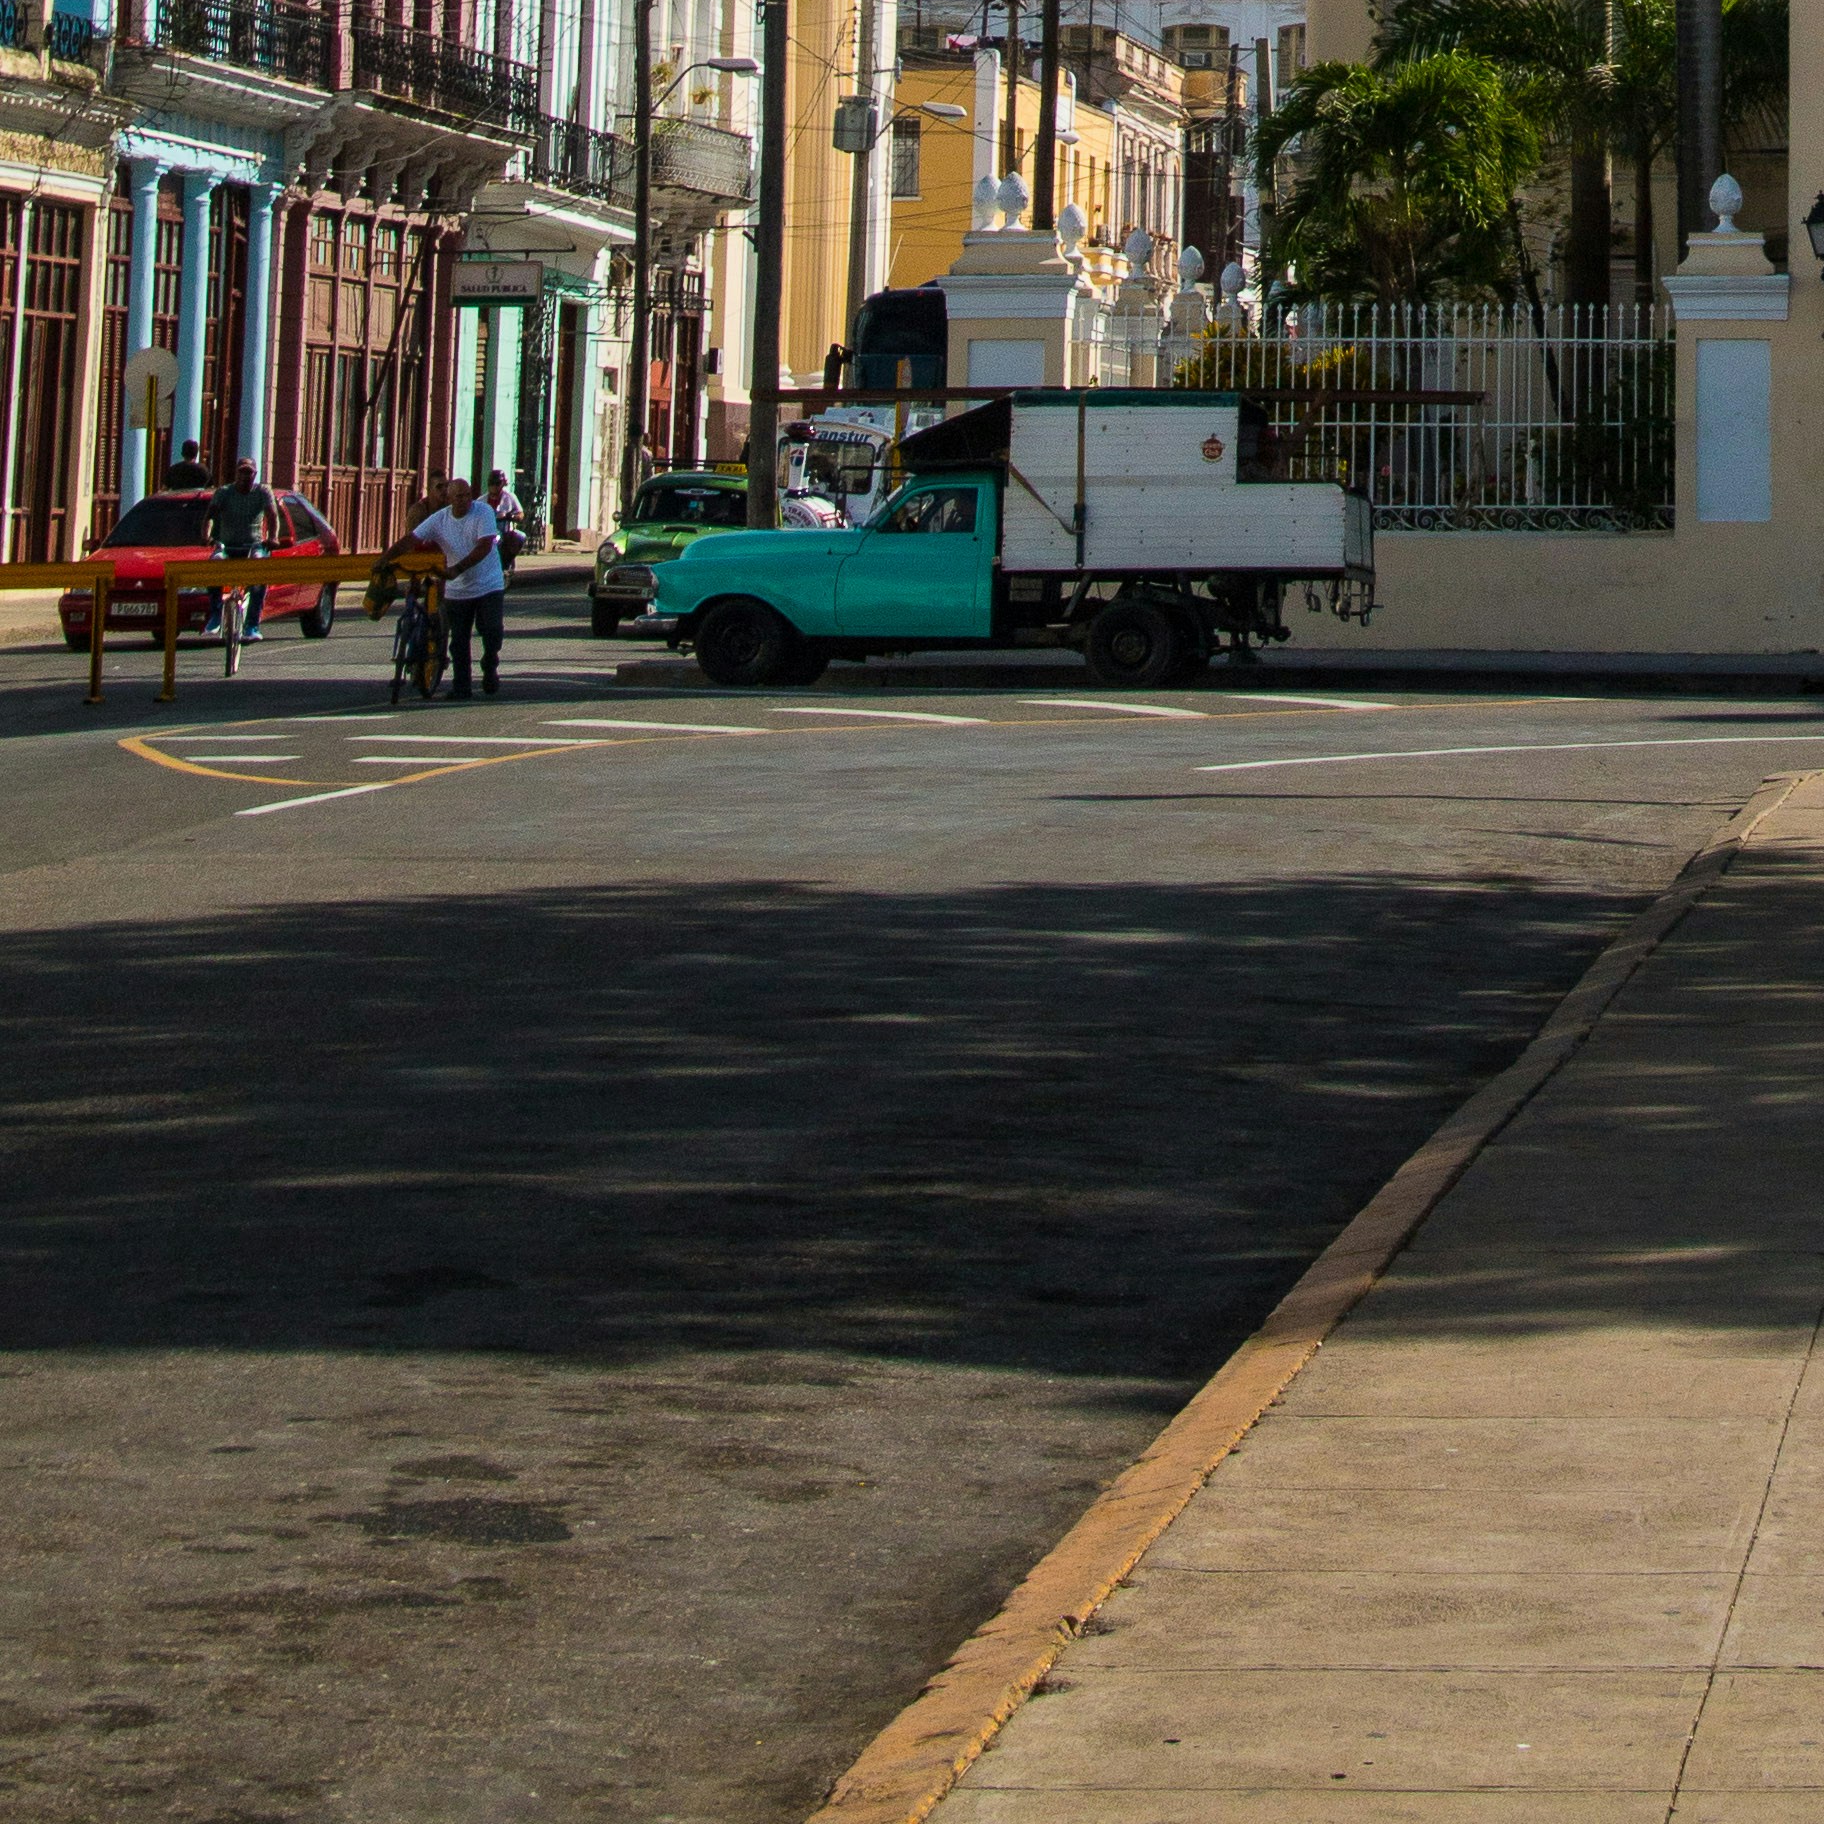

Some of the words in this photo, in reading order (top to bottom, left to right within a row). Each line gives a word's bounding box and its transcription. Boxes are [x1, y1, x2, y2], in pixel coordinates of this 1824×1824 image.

[461, 284, 489, 293] SALUD
[813, 429, 872, 444] ranstur
[720, 465, 742, 473] TAXI
